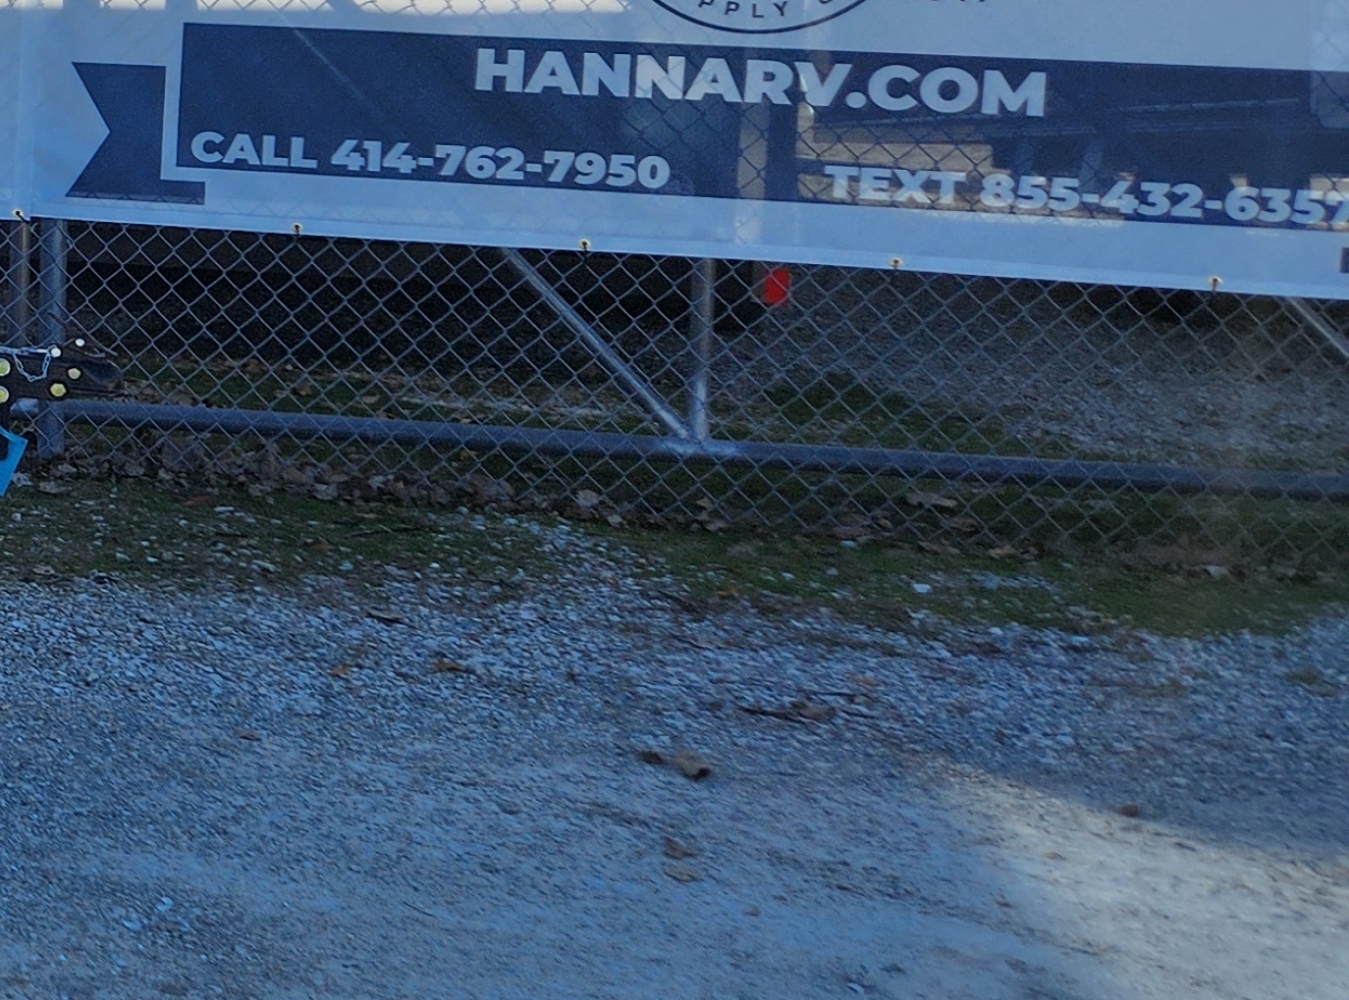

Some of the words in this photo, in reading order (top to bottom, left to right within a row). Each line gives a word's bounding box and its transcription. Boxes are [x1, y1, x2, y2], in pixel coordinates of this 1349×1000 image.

[473, 47, 1048, 118] HANNARV.COM
[190, 131, 318, 169] CALL
[331, 138, 671, 189] 414-762-7950
[824, 165, 967, 204] TEXT
